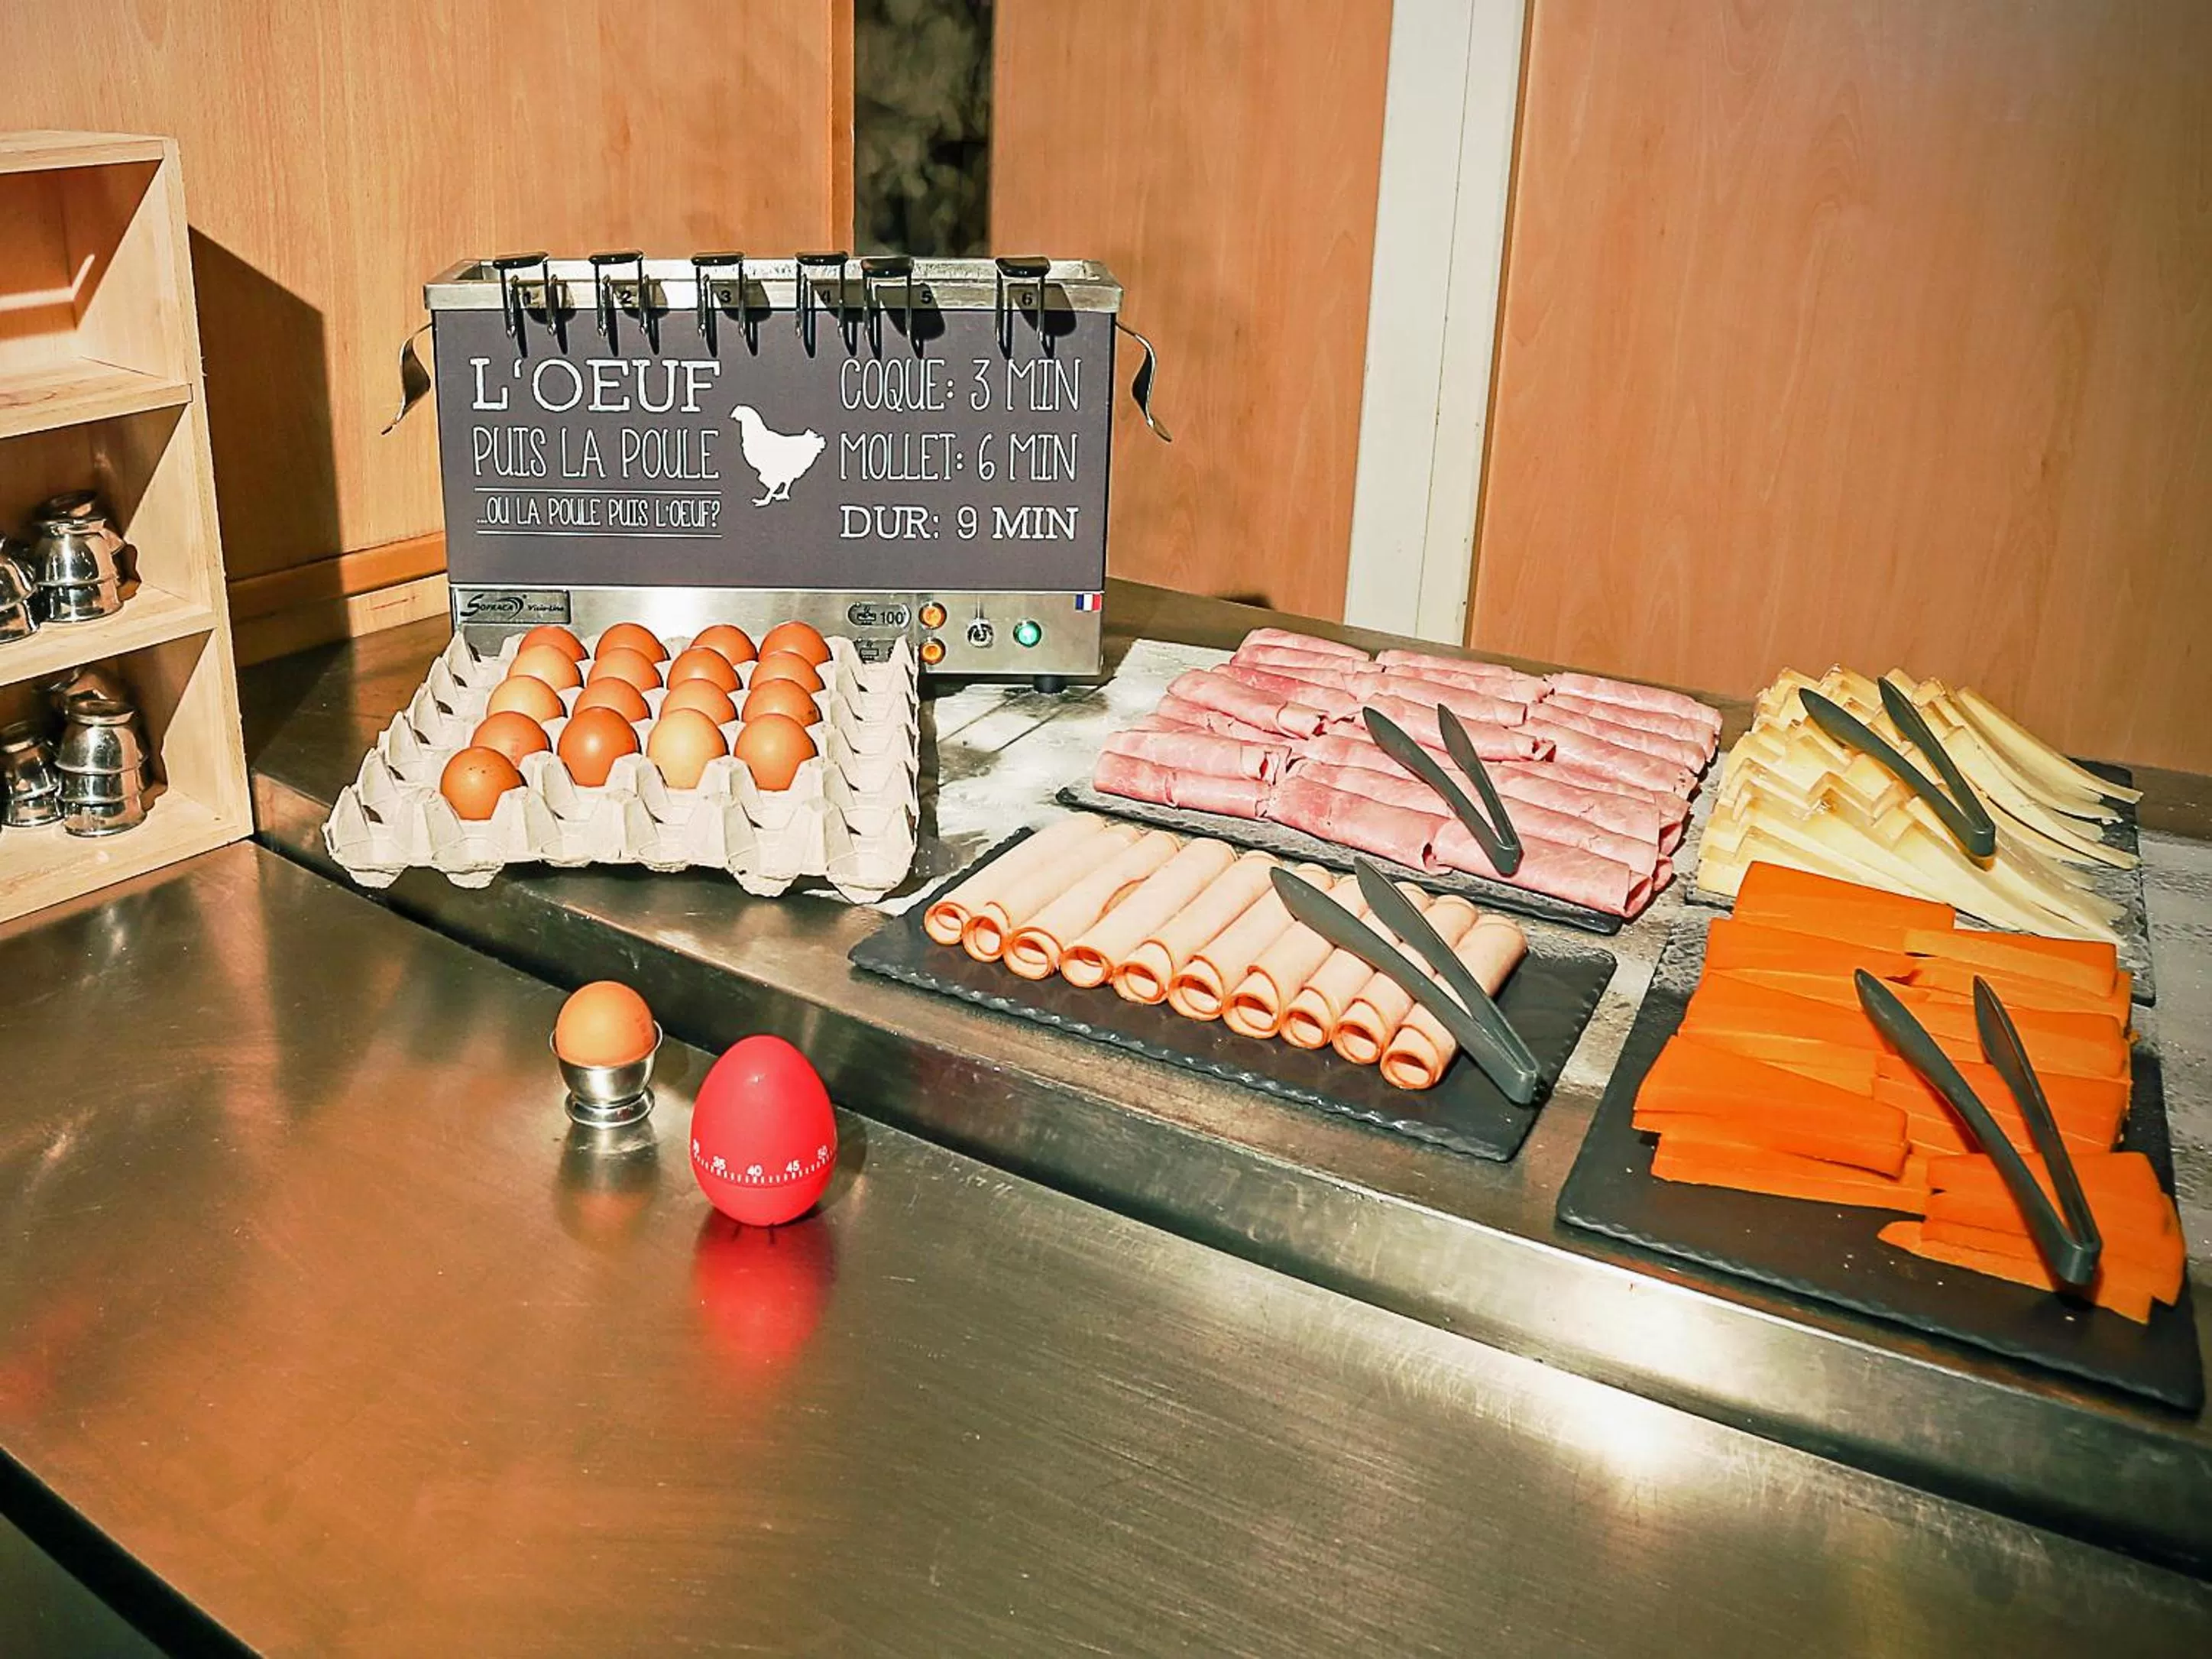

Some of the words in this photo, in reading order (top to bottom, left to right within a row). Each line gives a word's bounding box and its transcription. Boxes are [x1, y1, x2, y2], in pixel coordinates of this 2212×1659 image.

[620, 290, 632, 304] 2
[720, 290, 731, 303] 3
[920, 290, 931, 304] 5
[1022, 292, 1033, 306] 6
[469, 357, 721, 413] L'OEUF
[840, 358, 954, 412] COQUE:
[970, 358, 991, 411] 3
[1006, 358, 1082, 412] MIN
[472, 426, 547, 477] PUIS
[562, 427, 606, 478] LA
[621, 428, 720, 480] POULE
[840, 433, 964, 481] MOLLET:
[977, 434, 996, 481] 6
[1009, 433, 1078, 481] MIN
[516, 497, 541, 526] LA
[548, 498, 601, 526] POULE
[607, 498, 649, 527] PUIS
[655, 499, 721, 527] L'OEUF?
[840, 506, 940, 539] DUR:
[957, 507, 978, 536] 9
[993, 507, 1079, 539] MIN
[746, 1164, 763, 1178] 40
[785, 1159, 800, 1173] 45
